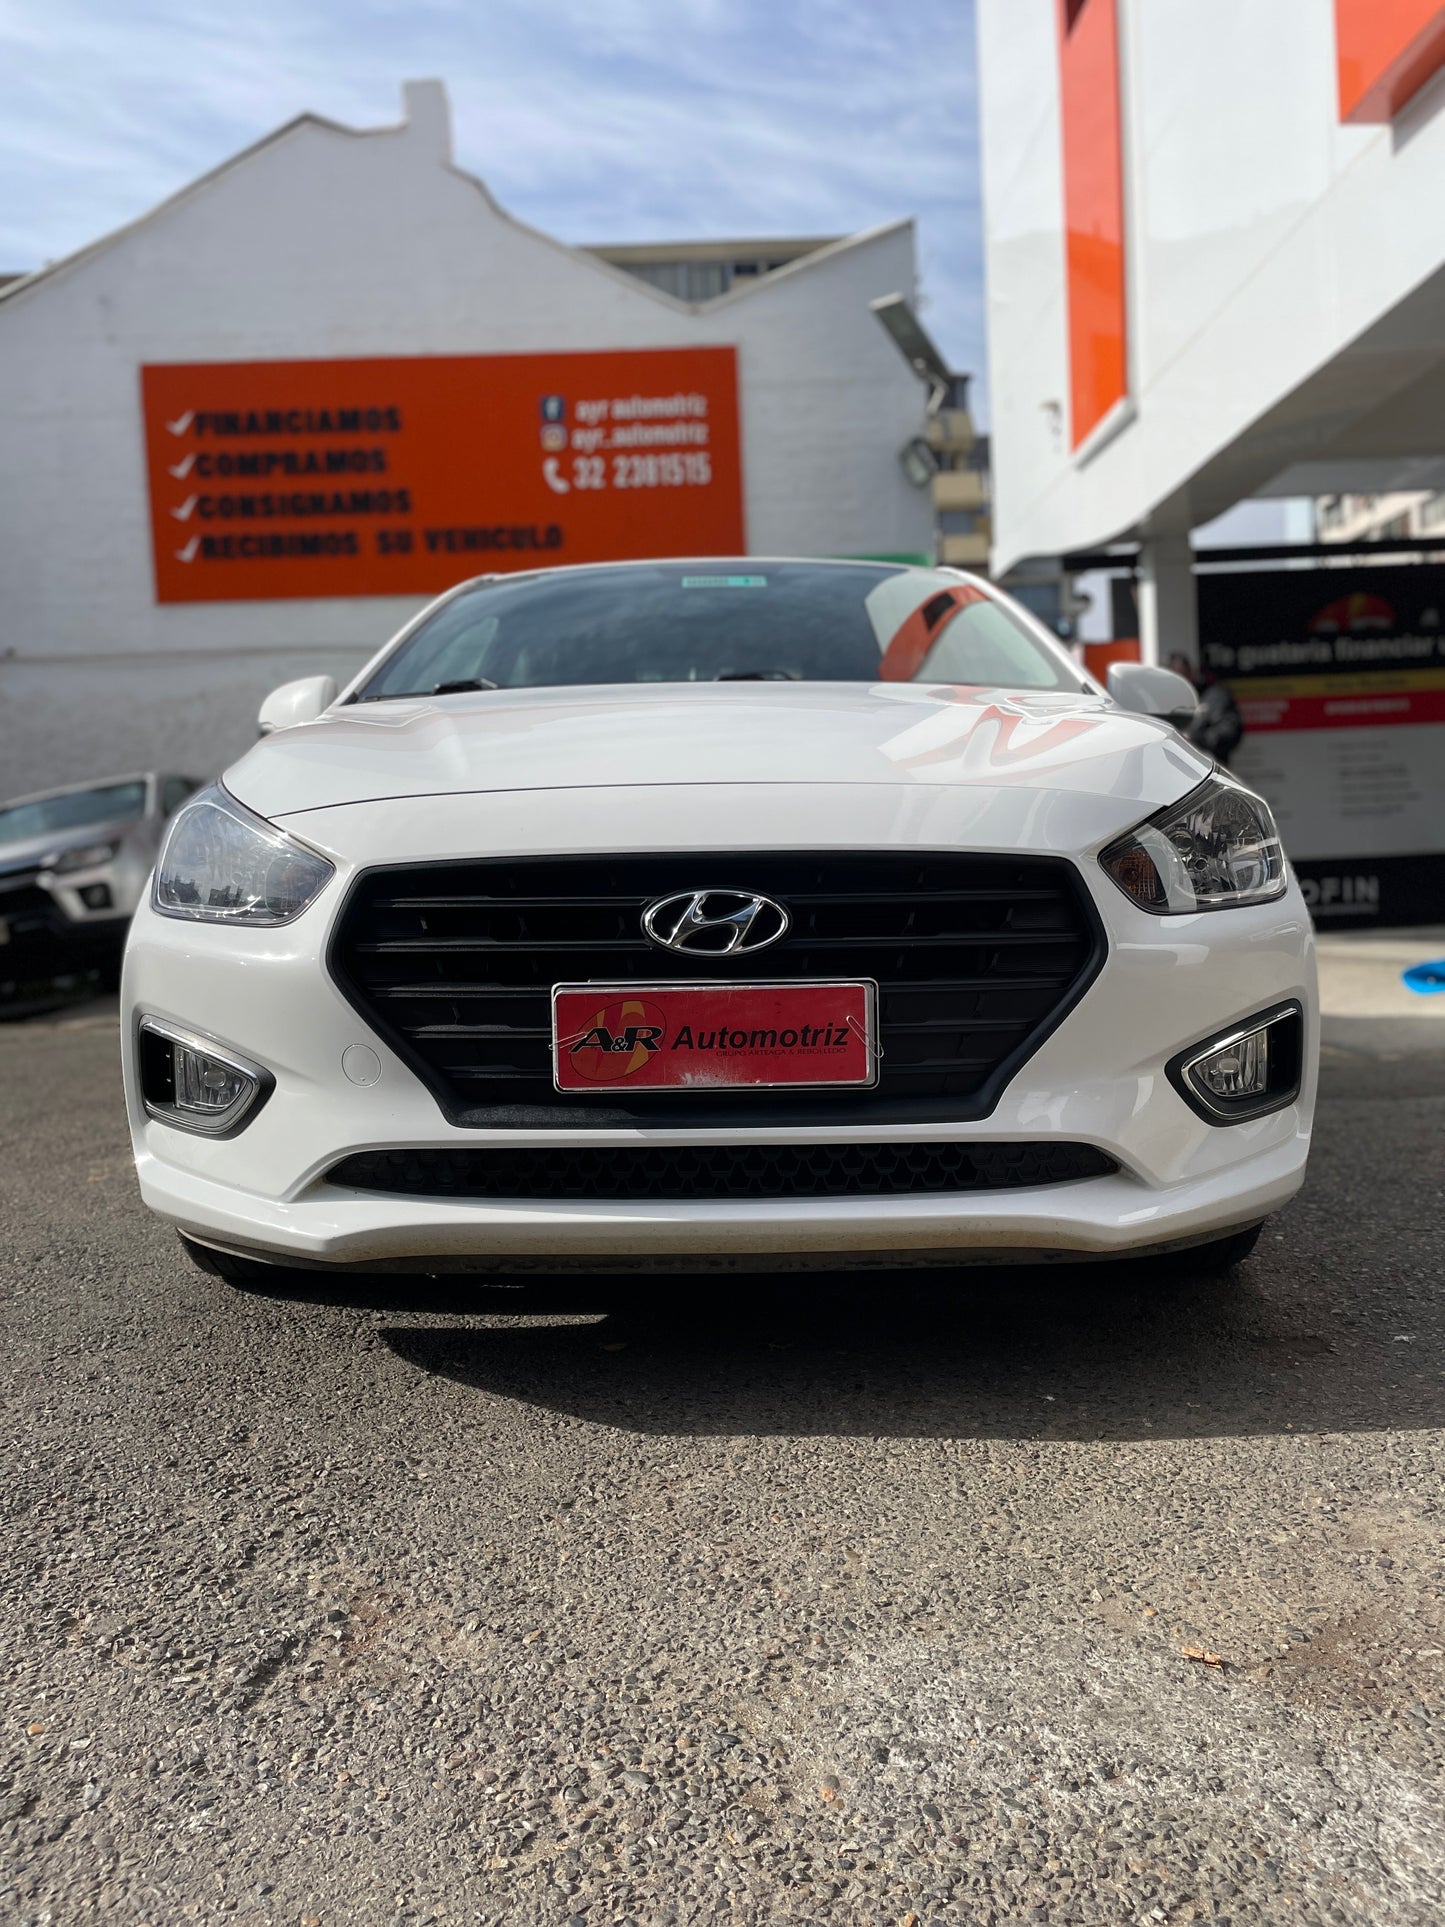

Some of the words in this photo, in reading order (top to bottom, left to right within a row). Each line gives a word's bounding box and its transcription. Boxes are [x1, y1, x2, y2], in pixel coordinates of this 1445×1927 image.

[611, 393, 708, 420] automotriz
[195, 408, 401, 437] FINANCIAMOS
[196, 449, 386, 478] COMPRAMOS
[572, 455, 607, 489] 32
[198, 490, 410, 519] CONSIGNAMOS
[202, 533, 357, 560] RECIBIMOS
[375, 530, 412, 555] SU
[424, 524, 562, 553] VEHICULO
[1206, 642, 1234, 667] Te
[569, 1026, 664, 1053] A&R
[671, 1022, 850, 1050] Automotriz
